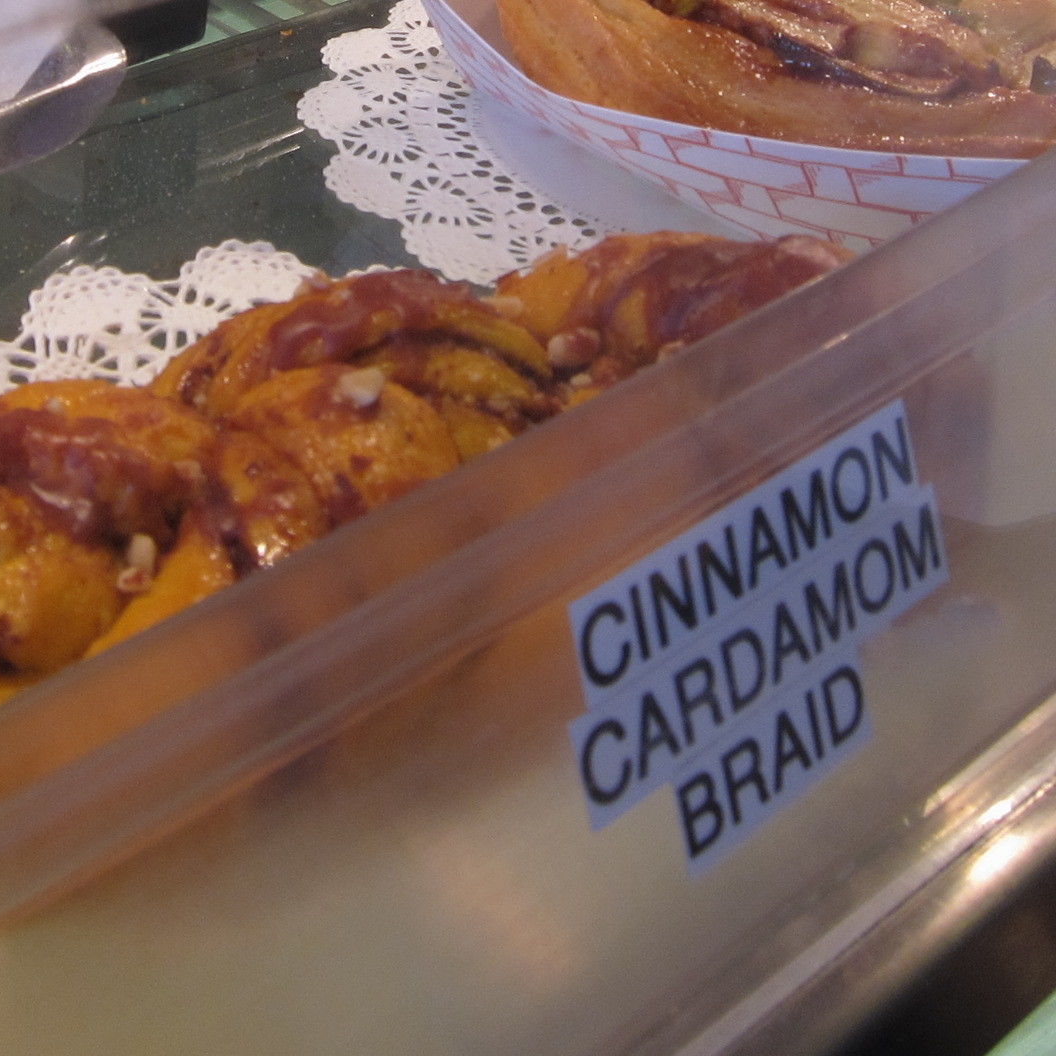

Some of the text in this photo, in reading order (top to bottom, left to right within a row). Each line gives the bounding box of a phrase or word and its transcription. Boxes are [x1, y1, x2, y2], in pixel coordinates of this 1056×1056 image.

[580, 417, 915, 688] CINNAMON
[580, 503, 941, 805] CARDAMOM
[676, 664, 864, 860] BRAID
